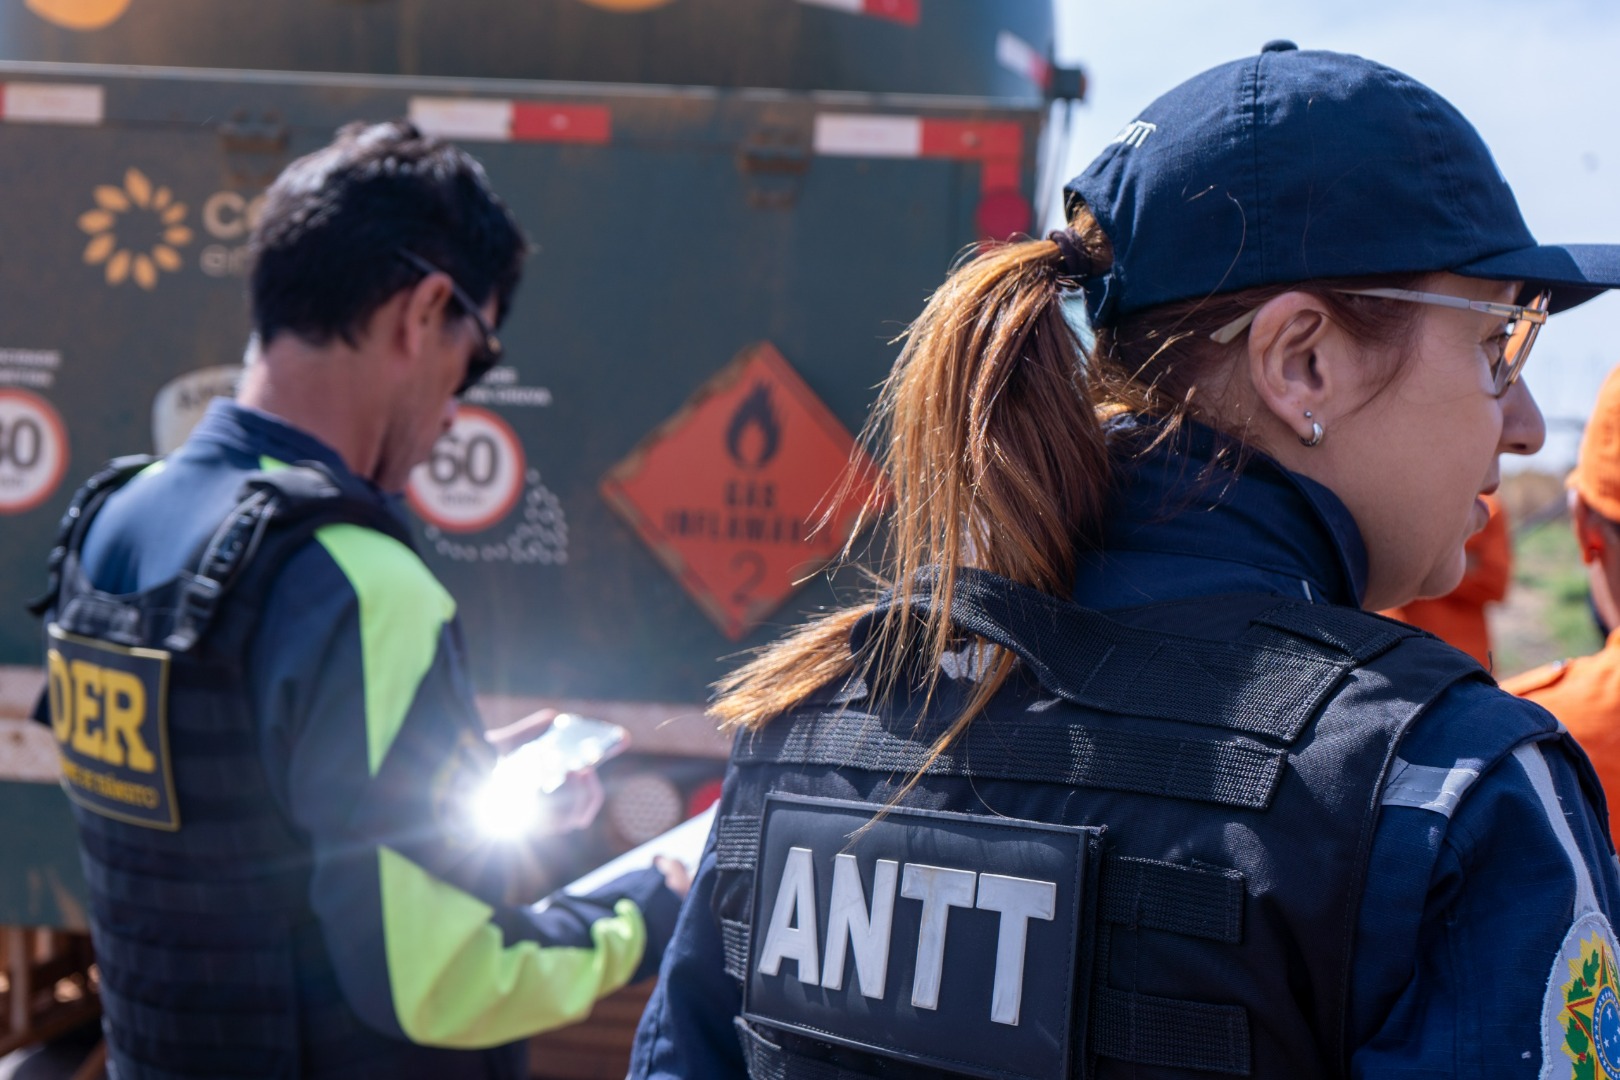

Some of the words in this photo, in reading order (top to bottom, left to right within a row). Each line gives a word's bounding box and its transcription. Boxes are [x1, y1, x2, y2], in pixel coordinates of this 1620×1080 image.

[429, 433, 499, 487] 60
[730, 549, 767, 606] 2
[48, 649, 155, 771] DER
[758, 846, 1057, 1026] ANTT
